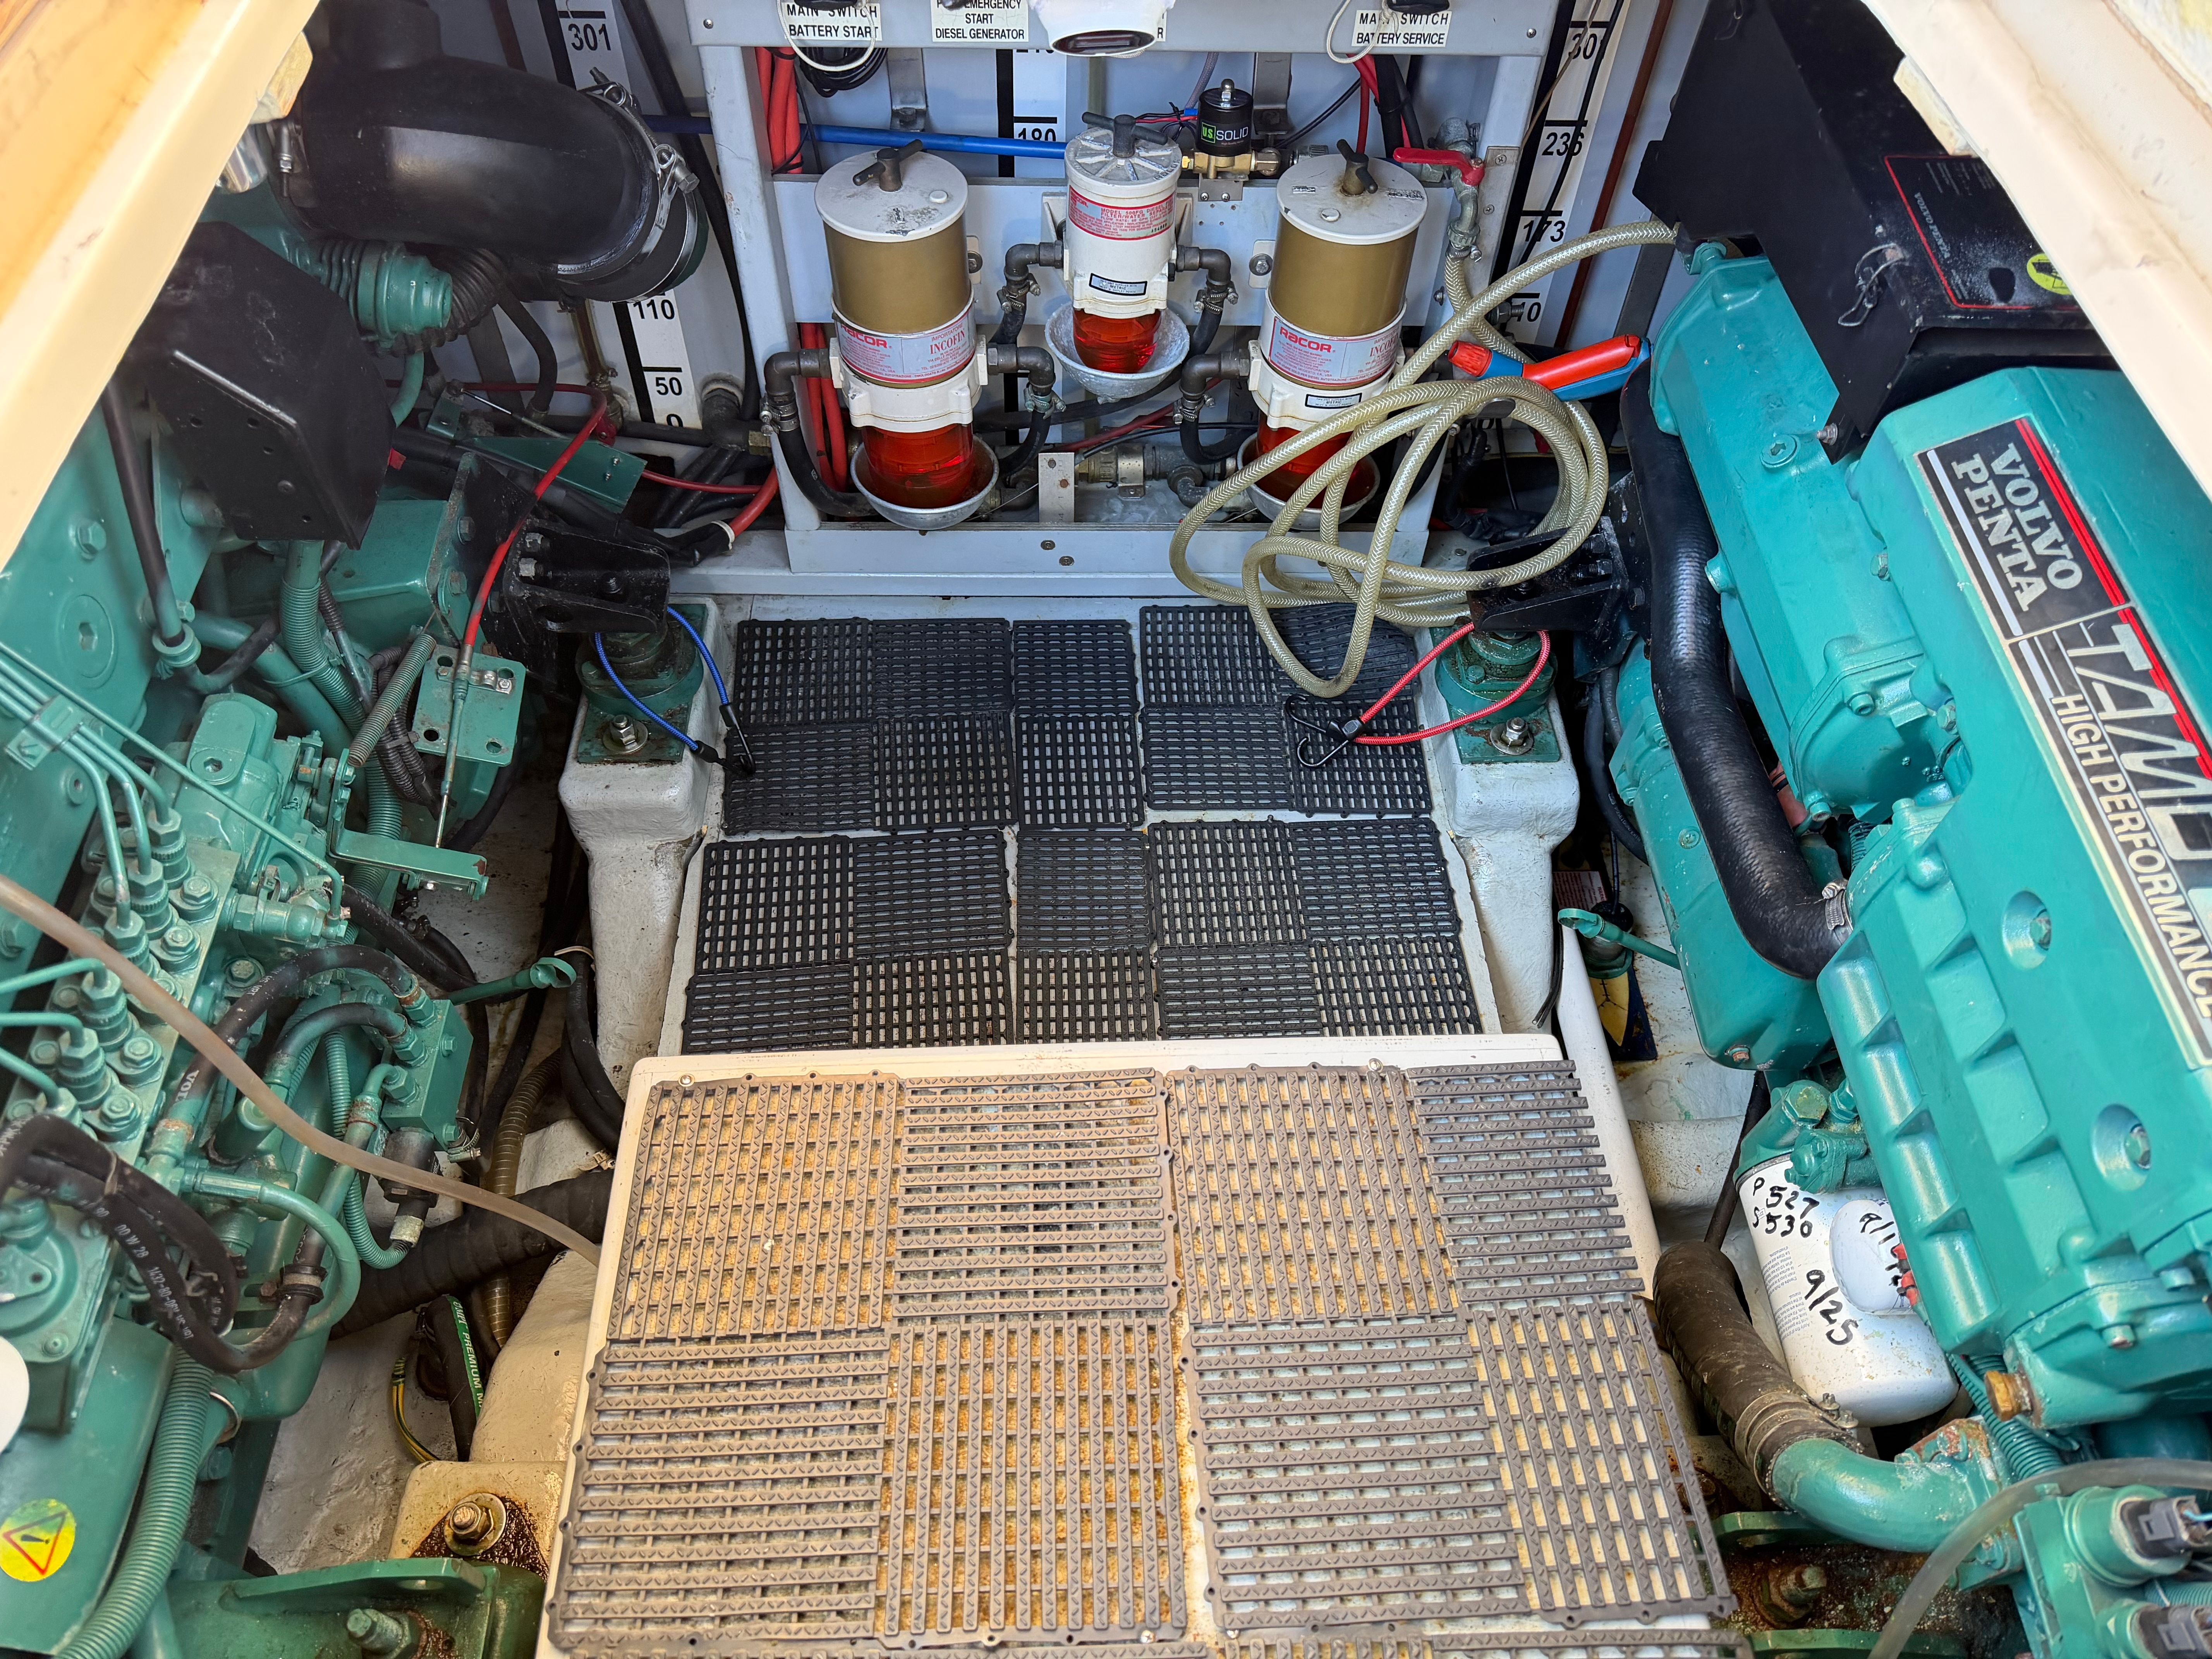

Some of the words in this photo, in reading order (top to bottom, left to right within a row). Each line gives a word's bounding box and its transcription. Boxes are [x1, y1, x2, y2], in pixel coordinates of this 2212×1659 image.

[787, 4, 819, 17] MAIN
[965, 13, 994, 24] START
[1359, 13, 1389, 25] MA
[1400, 13, 1448, 25] SWITCH
[568, 24, 611, 51] 301
[789, 24, 839, 37] BATTERY
[843, 26, 878, 38] START
[936, 28, 967, 39] DIESEL
[969, 28, 1024, 40] GENERATOR
[1357, 33, 1401, 44] BATTERY
[1402, 33, 1445, 45] SERVICE
[1568, 33, 1602, 60] 30
[1216, 126, 1249, 141] SOLID
[1542, 132, 1585, 156] 236
[1523, 220, 1565, 242] 173
[633, 299, 675, 320] 110
[930, 328, 965, 355] INCOFIN
[655, 377, 682, 396] 50
[1990, 443, 2083, 589] VOLVO
[1951, 453, 2047, 612] PENTA
[2051, 694, 2114, 766] HIGH
[1765, 1186, 1820, 1220] 527
[1765, 1212, 1813, 1238] 530
[1804, 1269, 1859, 1345] 9/25
[462, 1332, 482, 1389] PREMIUM
